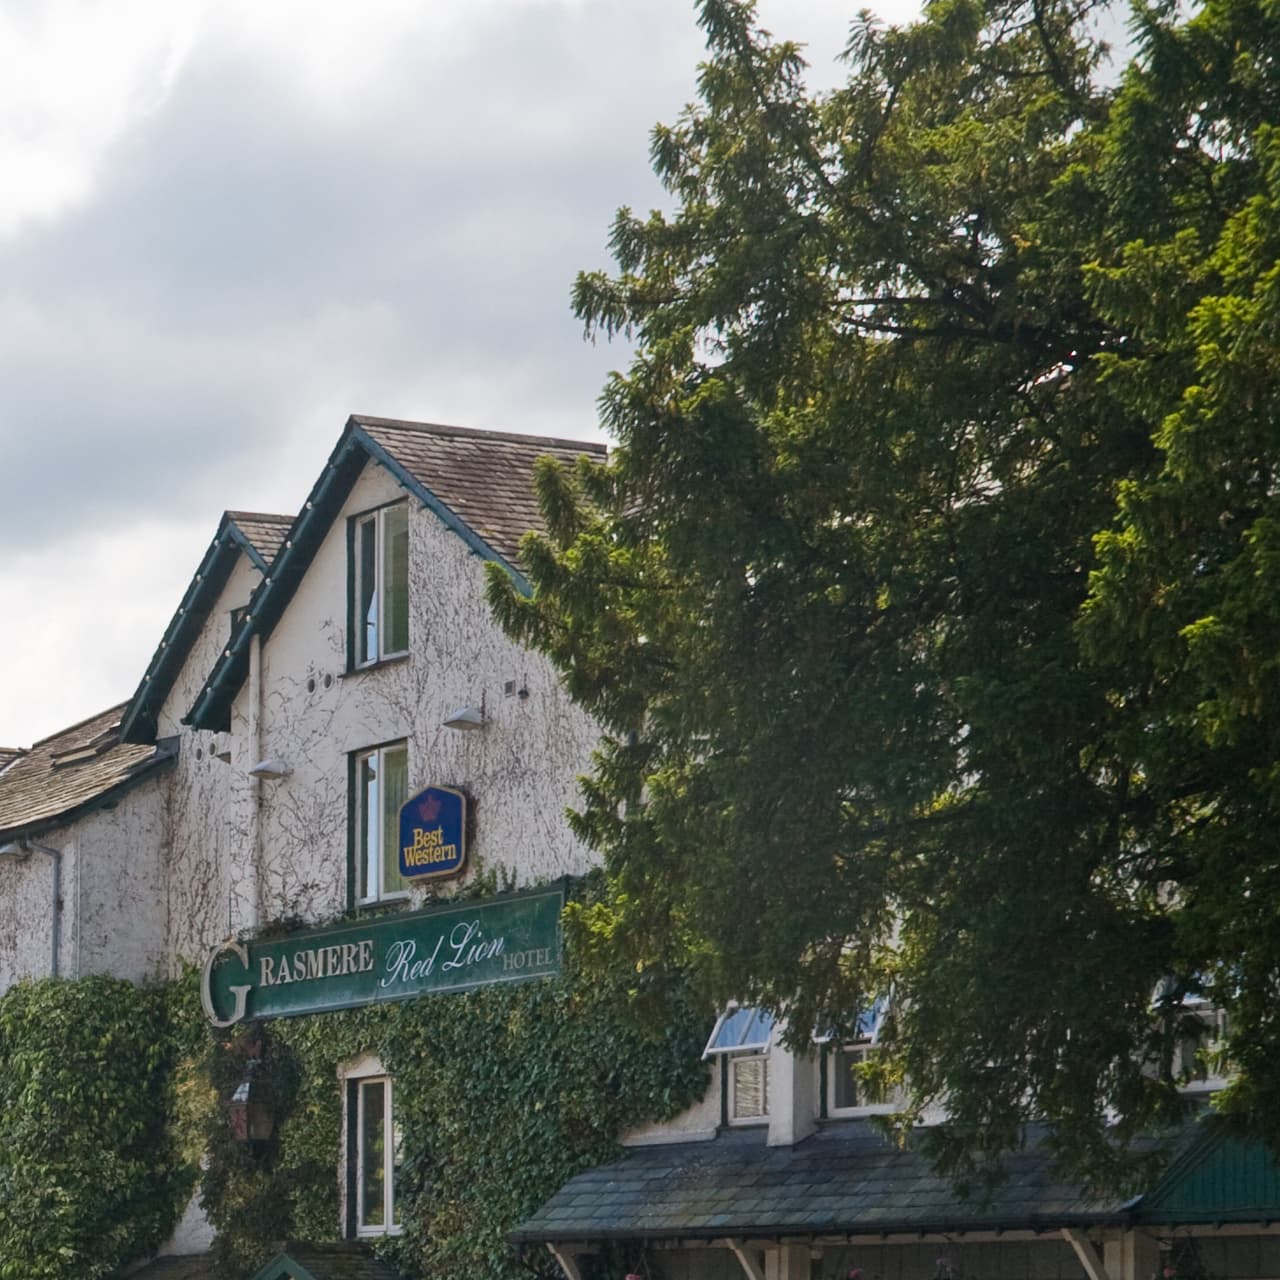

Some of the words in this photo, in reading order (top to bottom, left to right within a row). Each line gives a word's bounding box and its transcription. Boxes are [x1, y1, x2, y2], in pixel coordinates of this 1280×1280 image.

[413, 825, 443, 848] Best
[403, 844, 456, 867] Western
[200, 938, 375, 1028] GRASMERE
[379, 936, 445, 988] Red
[441, 919, 504, 972] Lion
[503, 946, 554, 971] HOTEL
